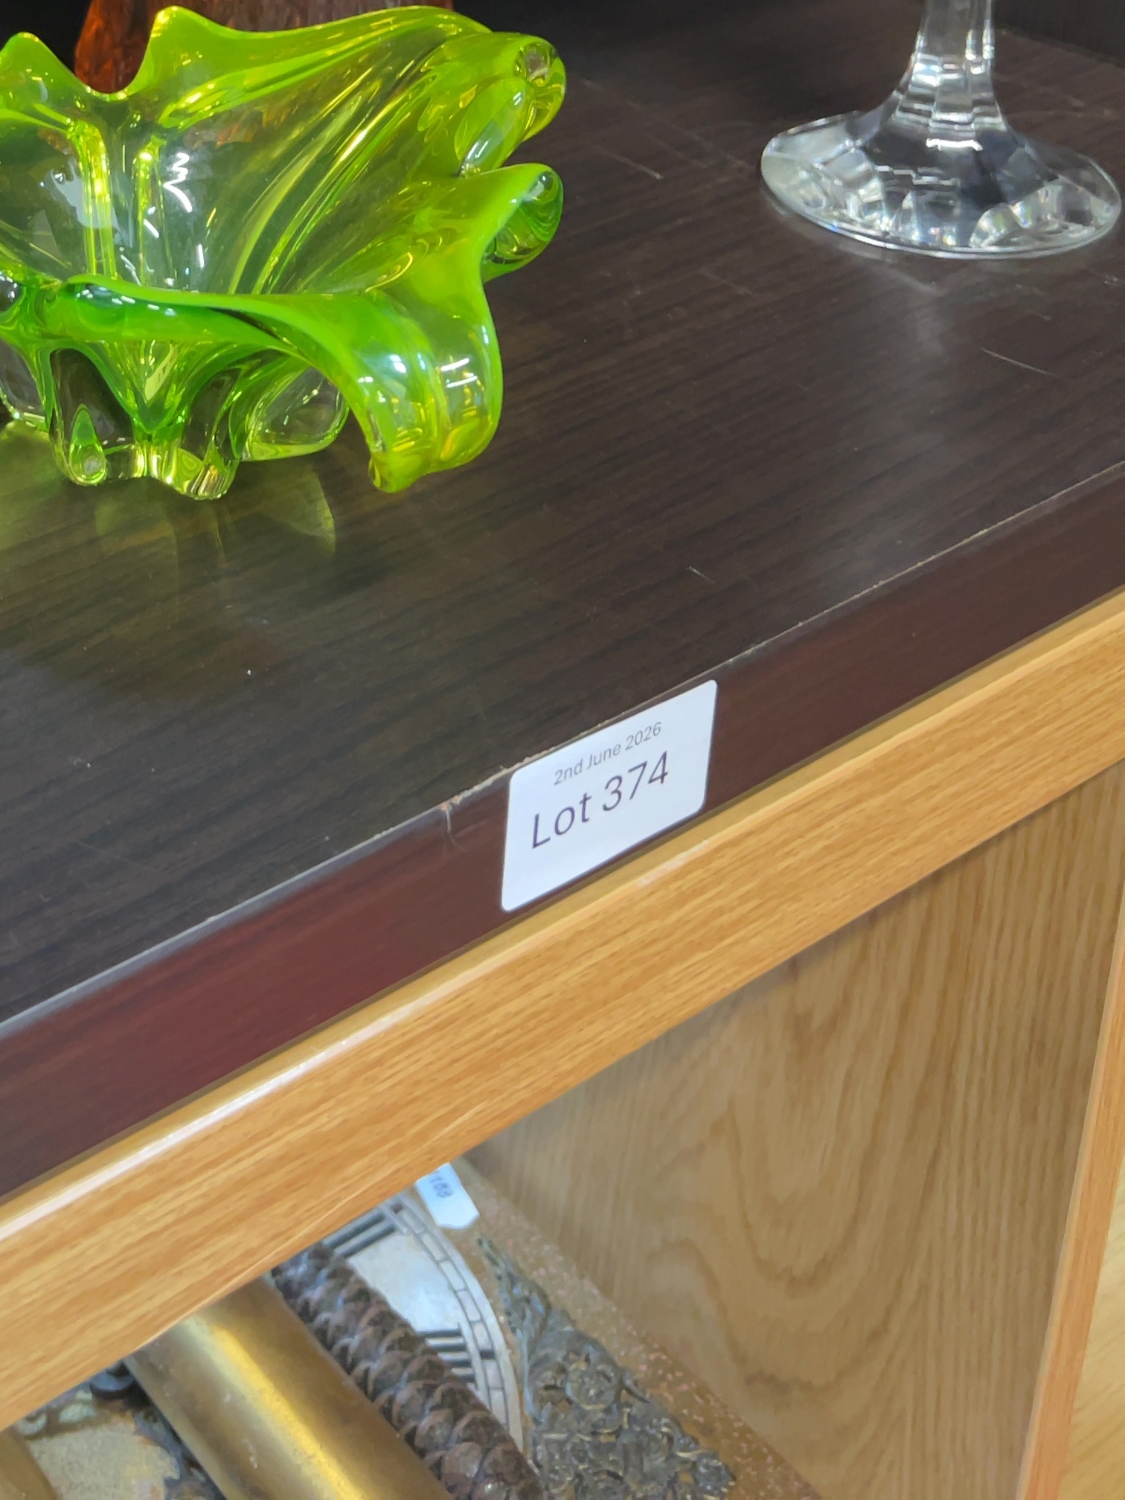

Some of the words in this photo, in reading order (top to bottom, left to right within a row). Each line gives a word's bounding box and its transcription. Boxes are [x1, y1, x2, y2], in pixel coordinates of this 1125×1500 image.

[553, 758, 584, 787] 2nd
[586, 743, 622, 771] June
[625, 721, 663, 751] 2026
[531, 792, 592, 849] Lot
[602, 750, 669, 812] 374
